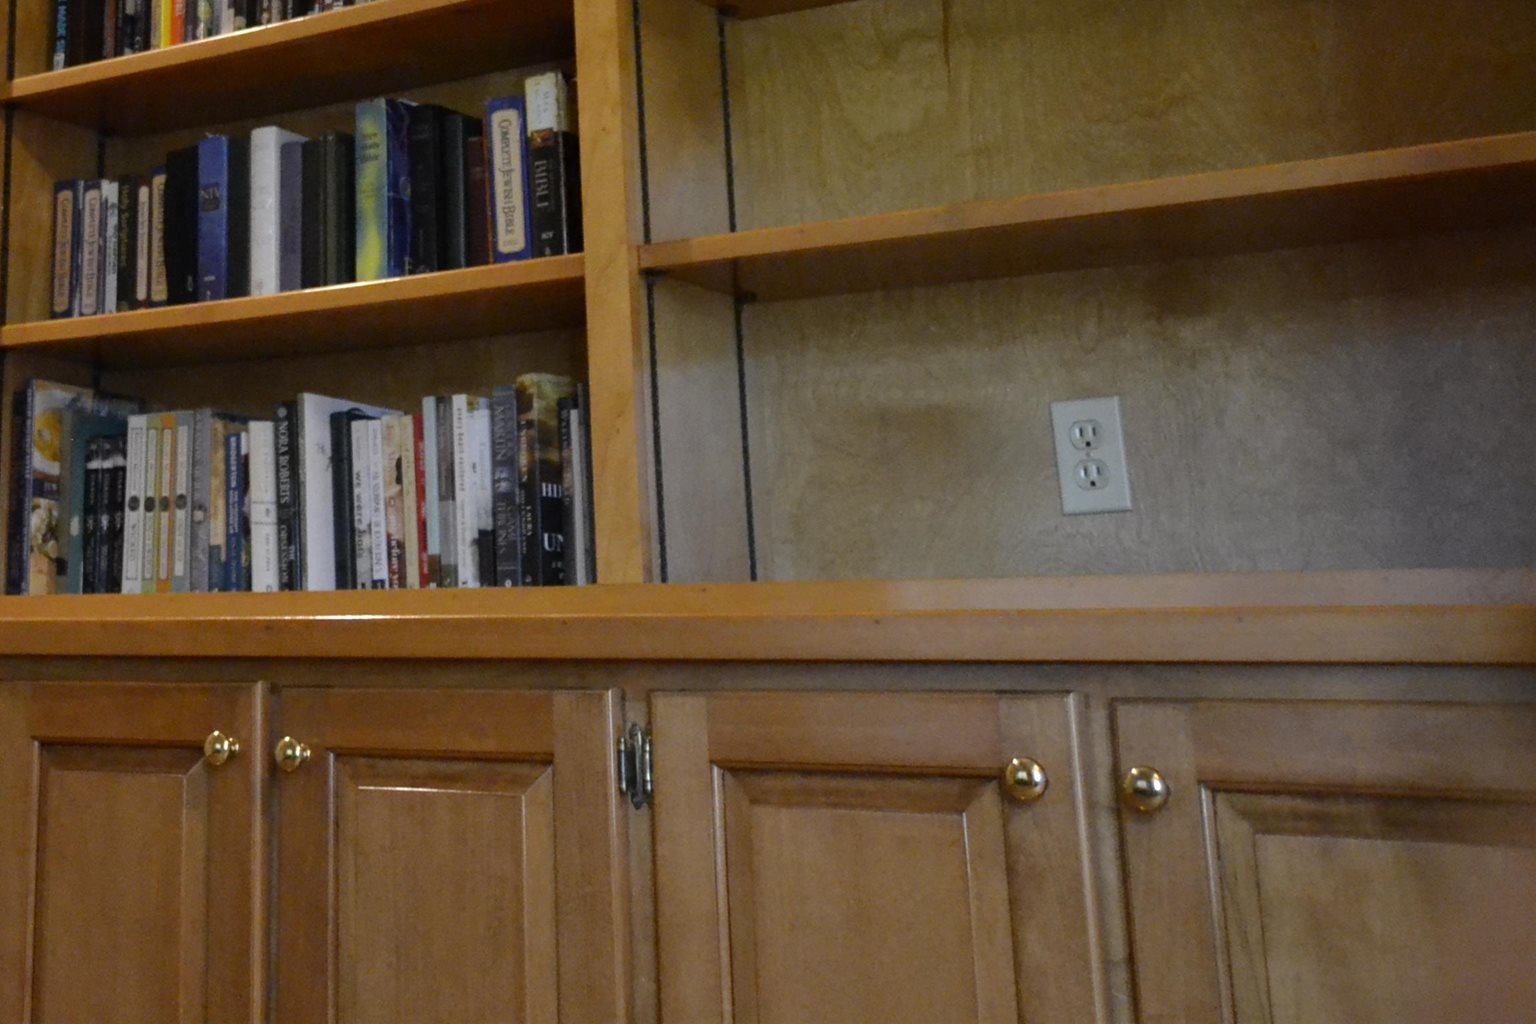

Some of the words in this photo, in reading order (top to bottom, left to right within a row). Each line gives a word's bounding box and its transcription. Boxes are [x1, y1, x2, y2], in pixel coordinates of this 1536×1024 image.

[499, 119, 514, 168] COMPLETE
[498, 168, 515, 205] JEWISH
[534, 159, 549, 211] BIBLE
[503, 206, 518, 236] BIBLE
[278, 421, 289, 454] NORA
[493, 404, 508, 460] MARTIN
[229, 436, 238, 488] BRIDGERTON
[279, 455, 290, 504] ROBERTS
[389, 537, 401, 570] before
